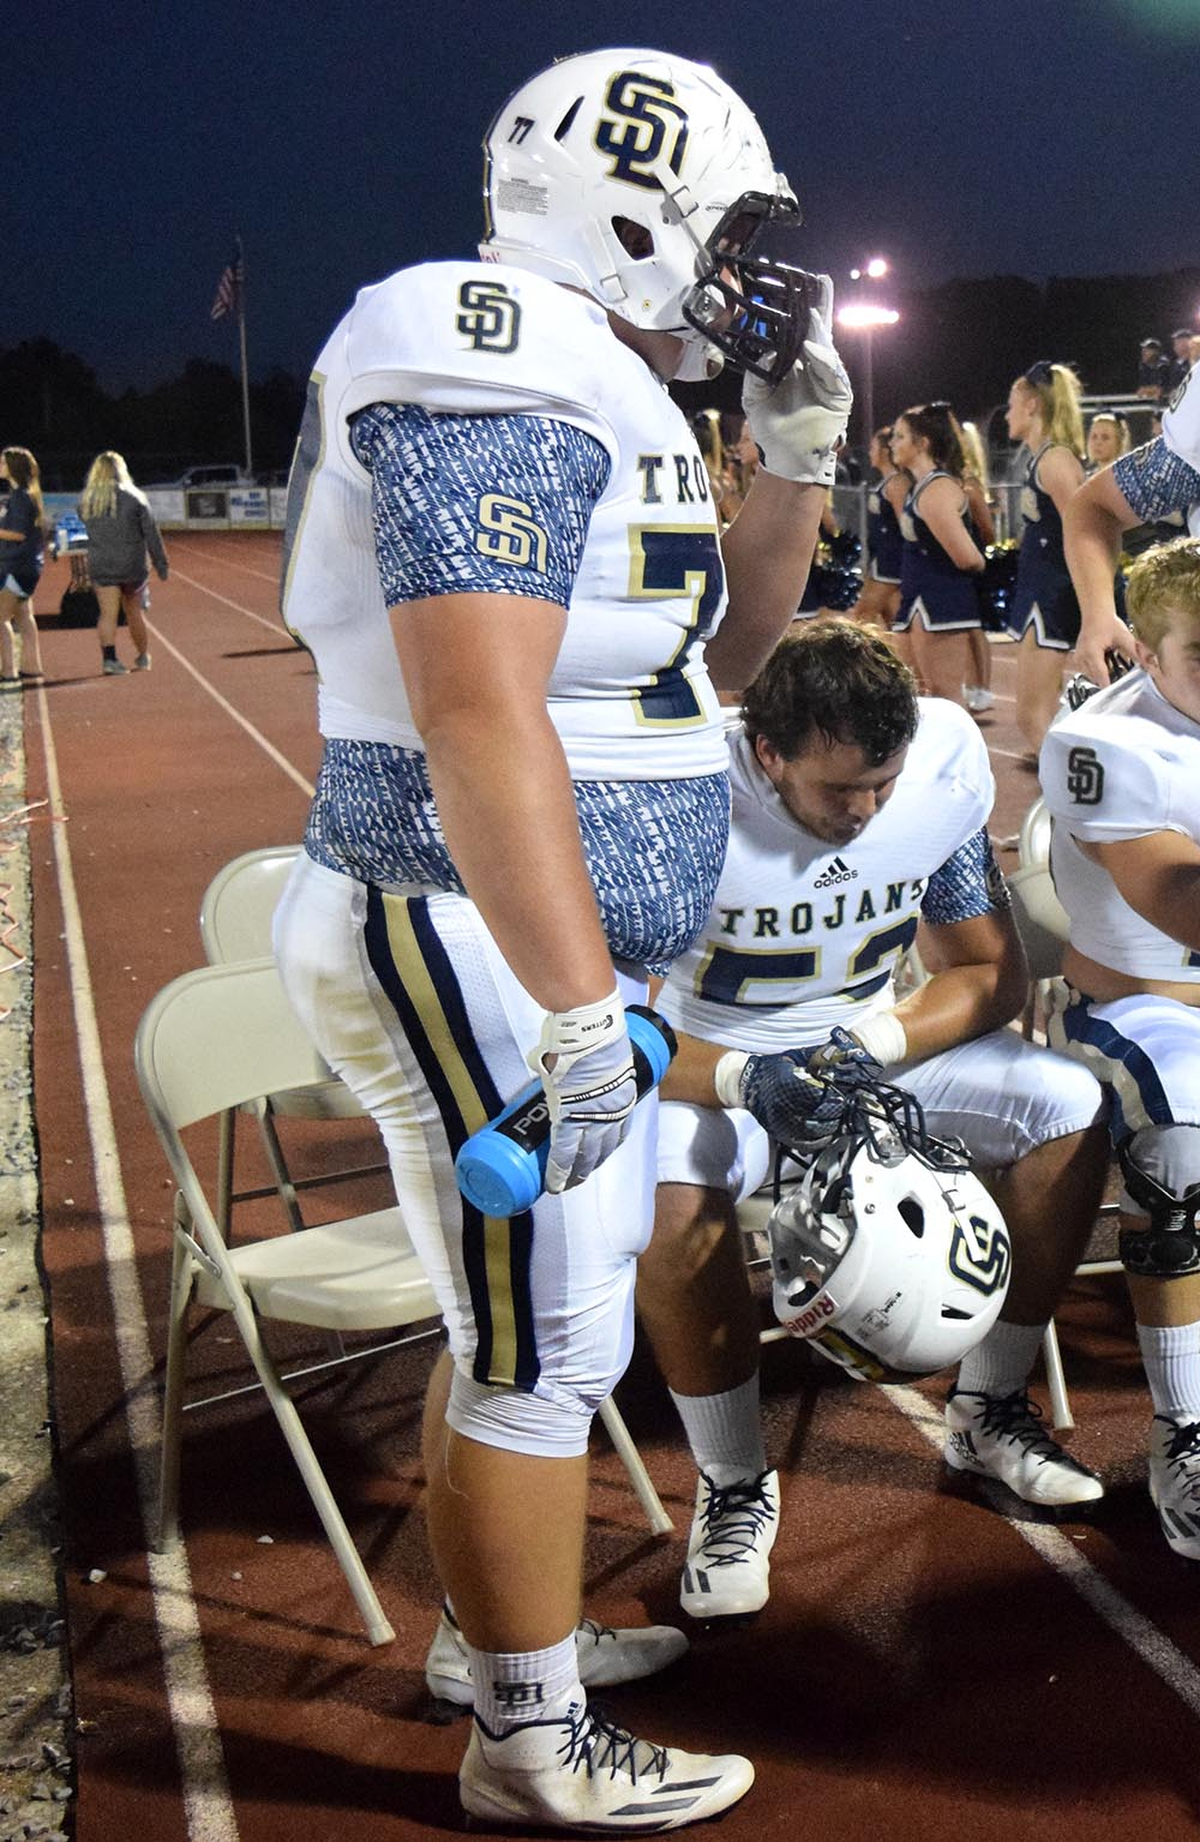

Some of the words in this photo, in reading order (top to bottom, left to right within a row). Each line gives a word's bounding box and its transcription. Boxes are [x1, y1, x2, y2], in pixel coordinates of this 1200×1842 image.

[508, 116, 535, 144] 77
[592, 70, 690, 192] SD
[456, 280, 521, 354] SD
[1067, 746, 1105, 805] SD
[719, 878, 924, 938] TROJANS
[814, 869, 858, 889] adidas
